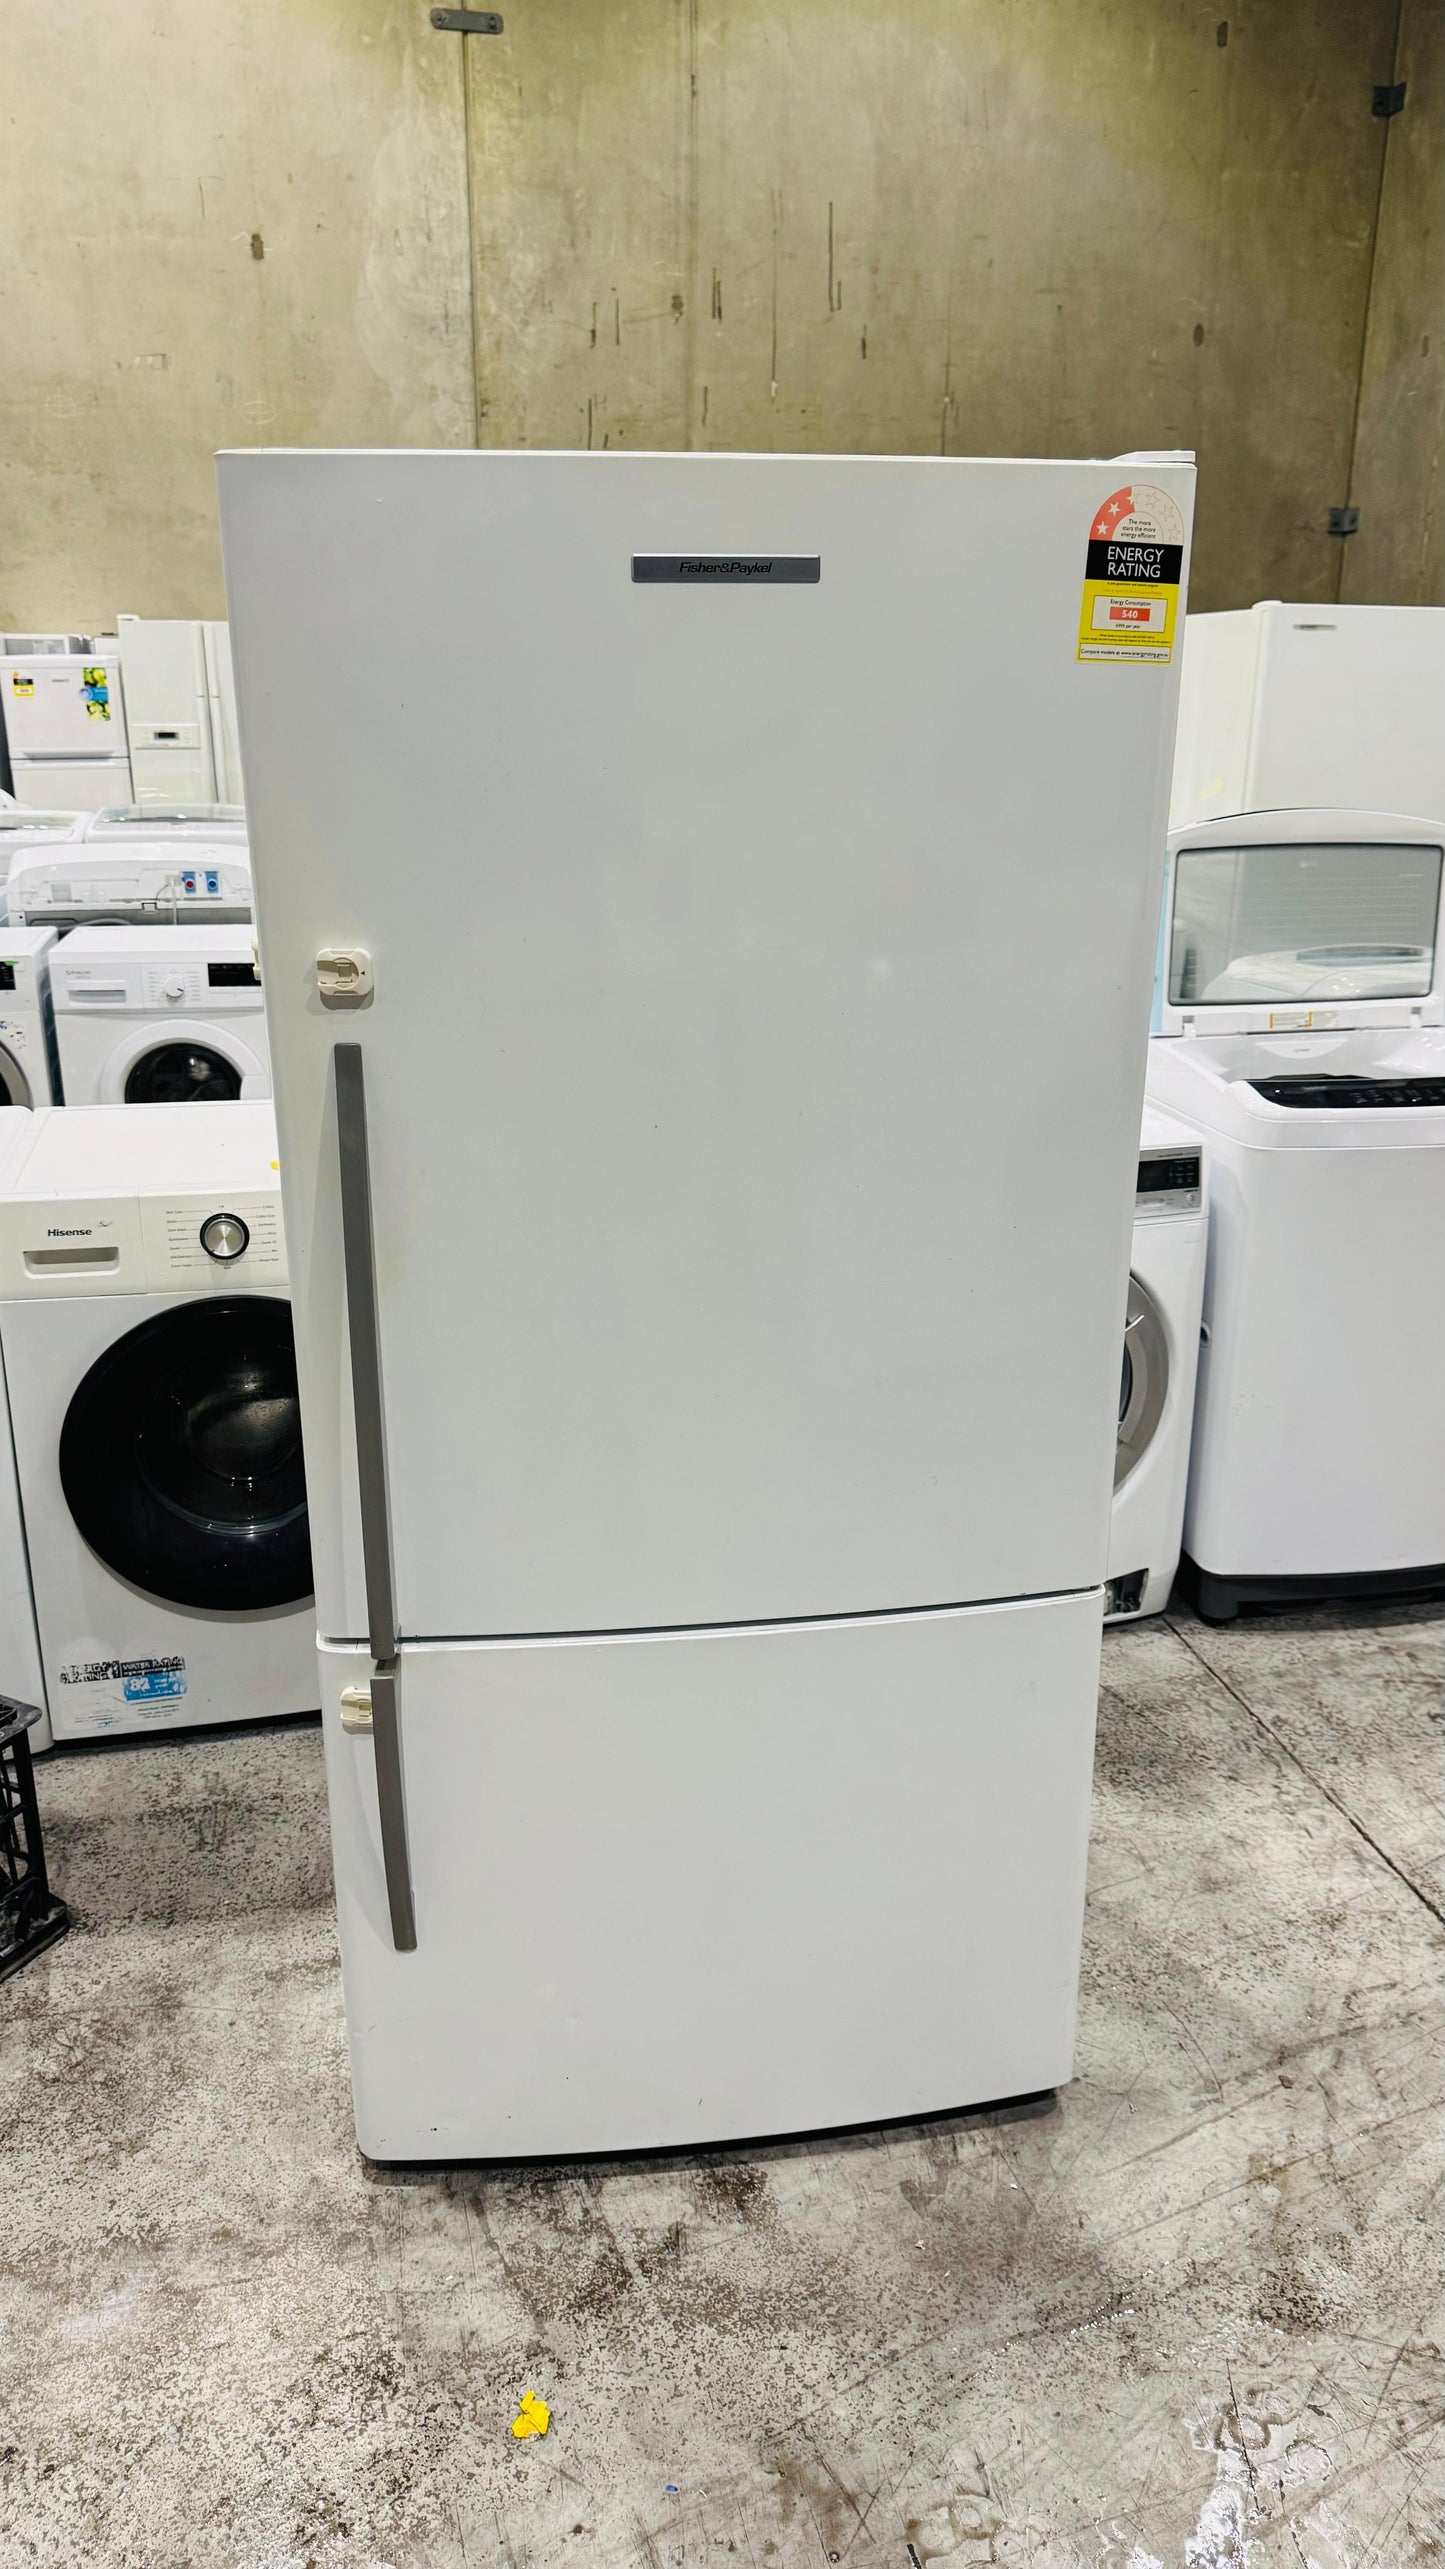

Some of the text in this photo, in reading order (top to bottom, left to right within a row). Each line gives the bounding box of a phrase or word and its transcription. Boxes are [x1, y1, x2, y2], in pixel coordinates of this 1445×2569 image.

[1107, 546, 1164, 562] ENERGY
[679, 562, 773, 575] Fisher&Paykel
[1107, 562, 1161, 578] RATING
[1122, 610, 1138, 618] 540
[48, 1228, 92, 1236] Hisense
